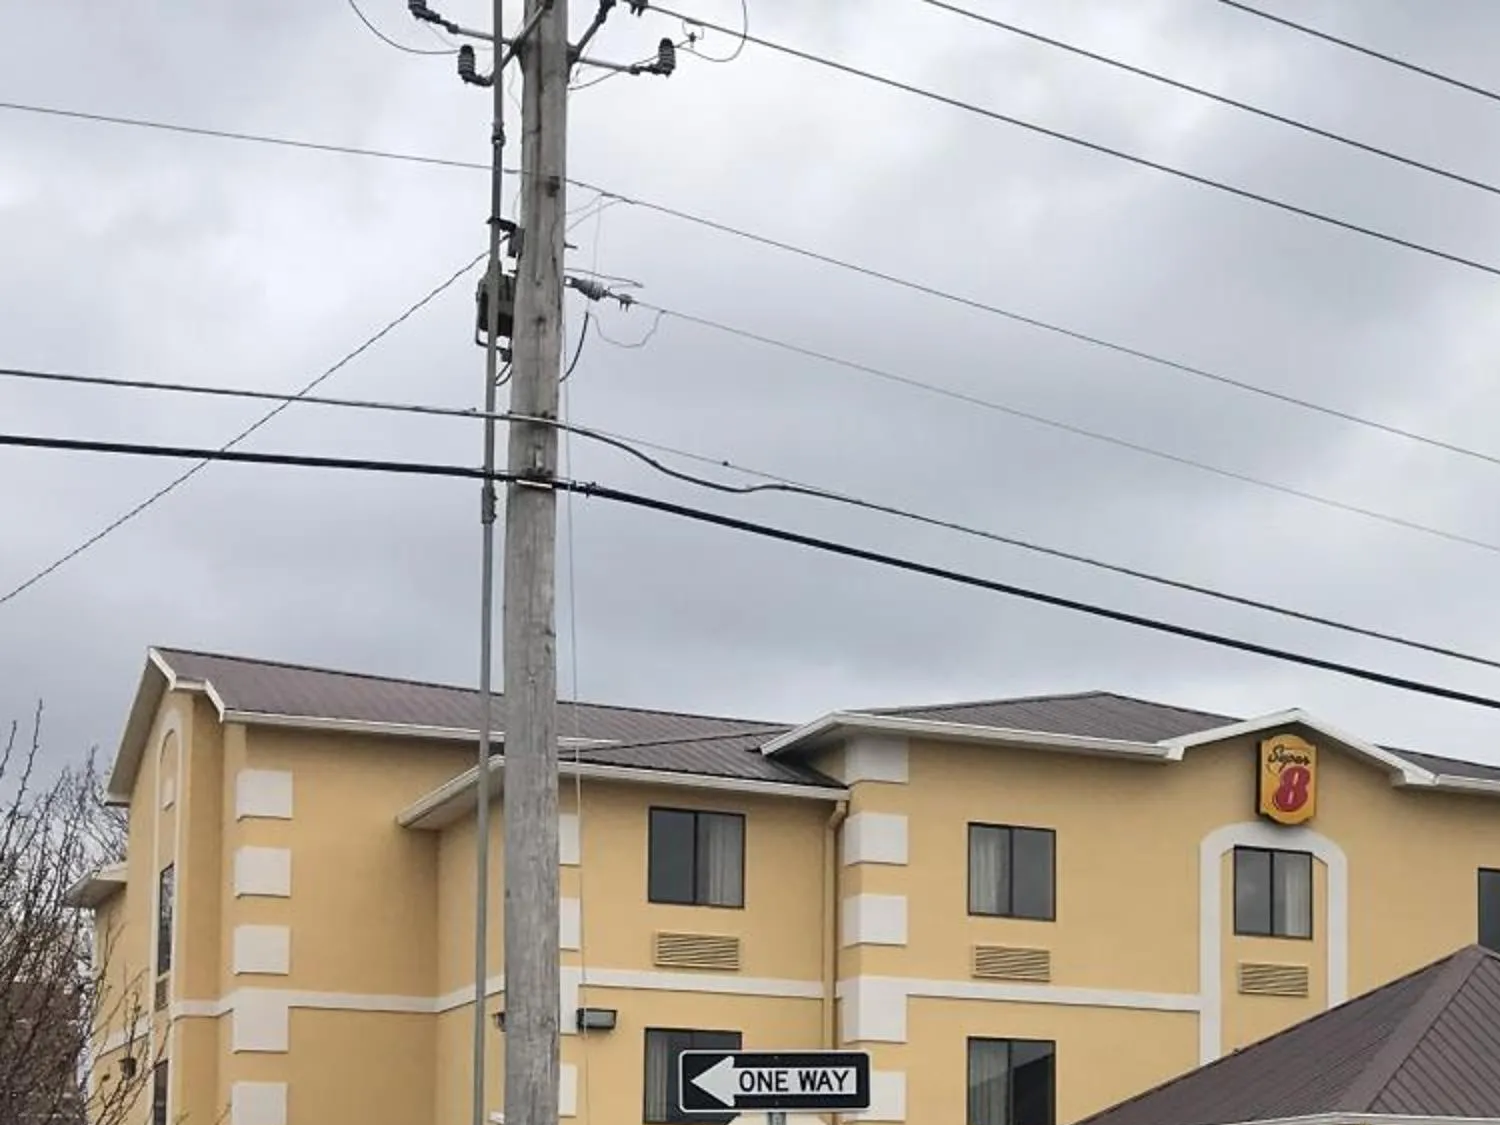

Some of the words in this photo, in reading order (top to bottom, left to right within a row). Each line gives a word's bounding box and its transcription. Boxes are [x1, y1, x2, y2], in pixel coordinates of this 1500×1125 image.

[1272, 765, 1311, 812] 8
[739, 1070, 788, 1092] ONE
[798, 1070, 849, 1092] WAY
